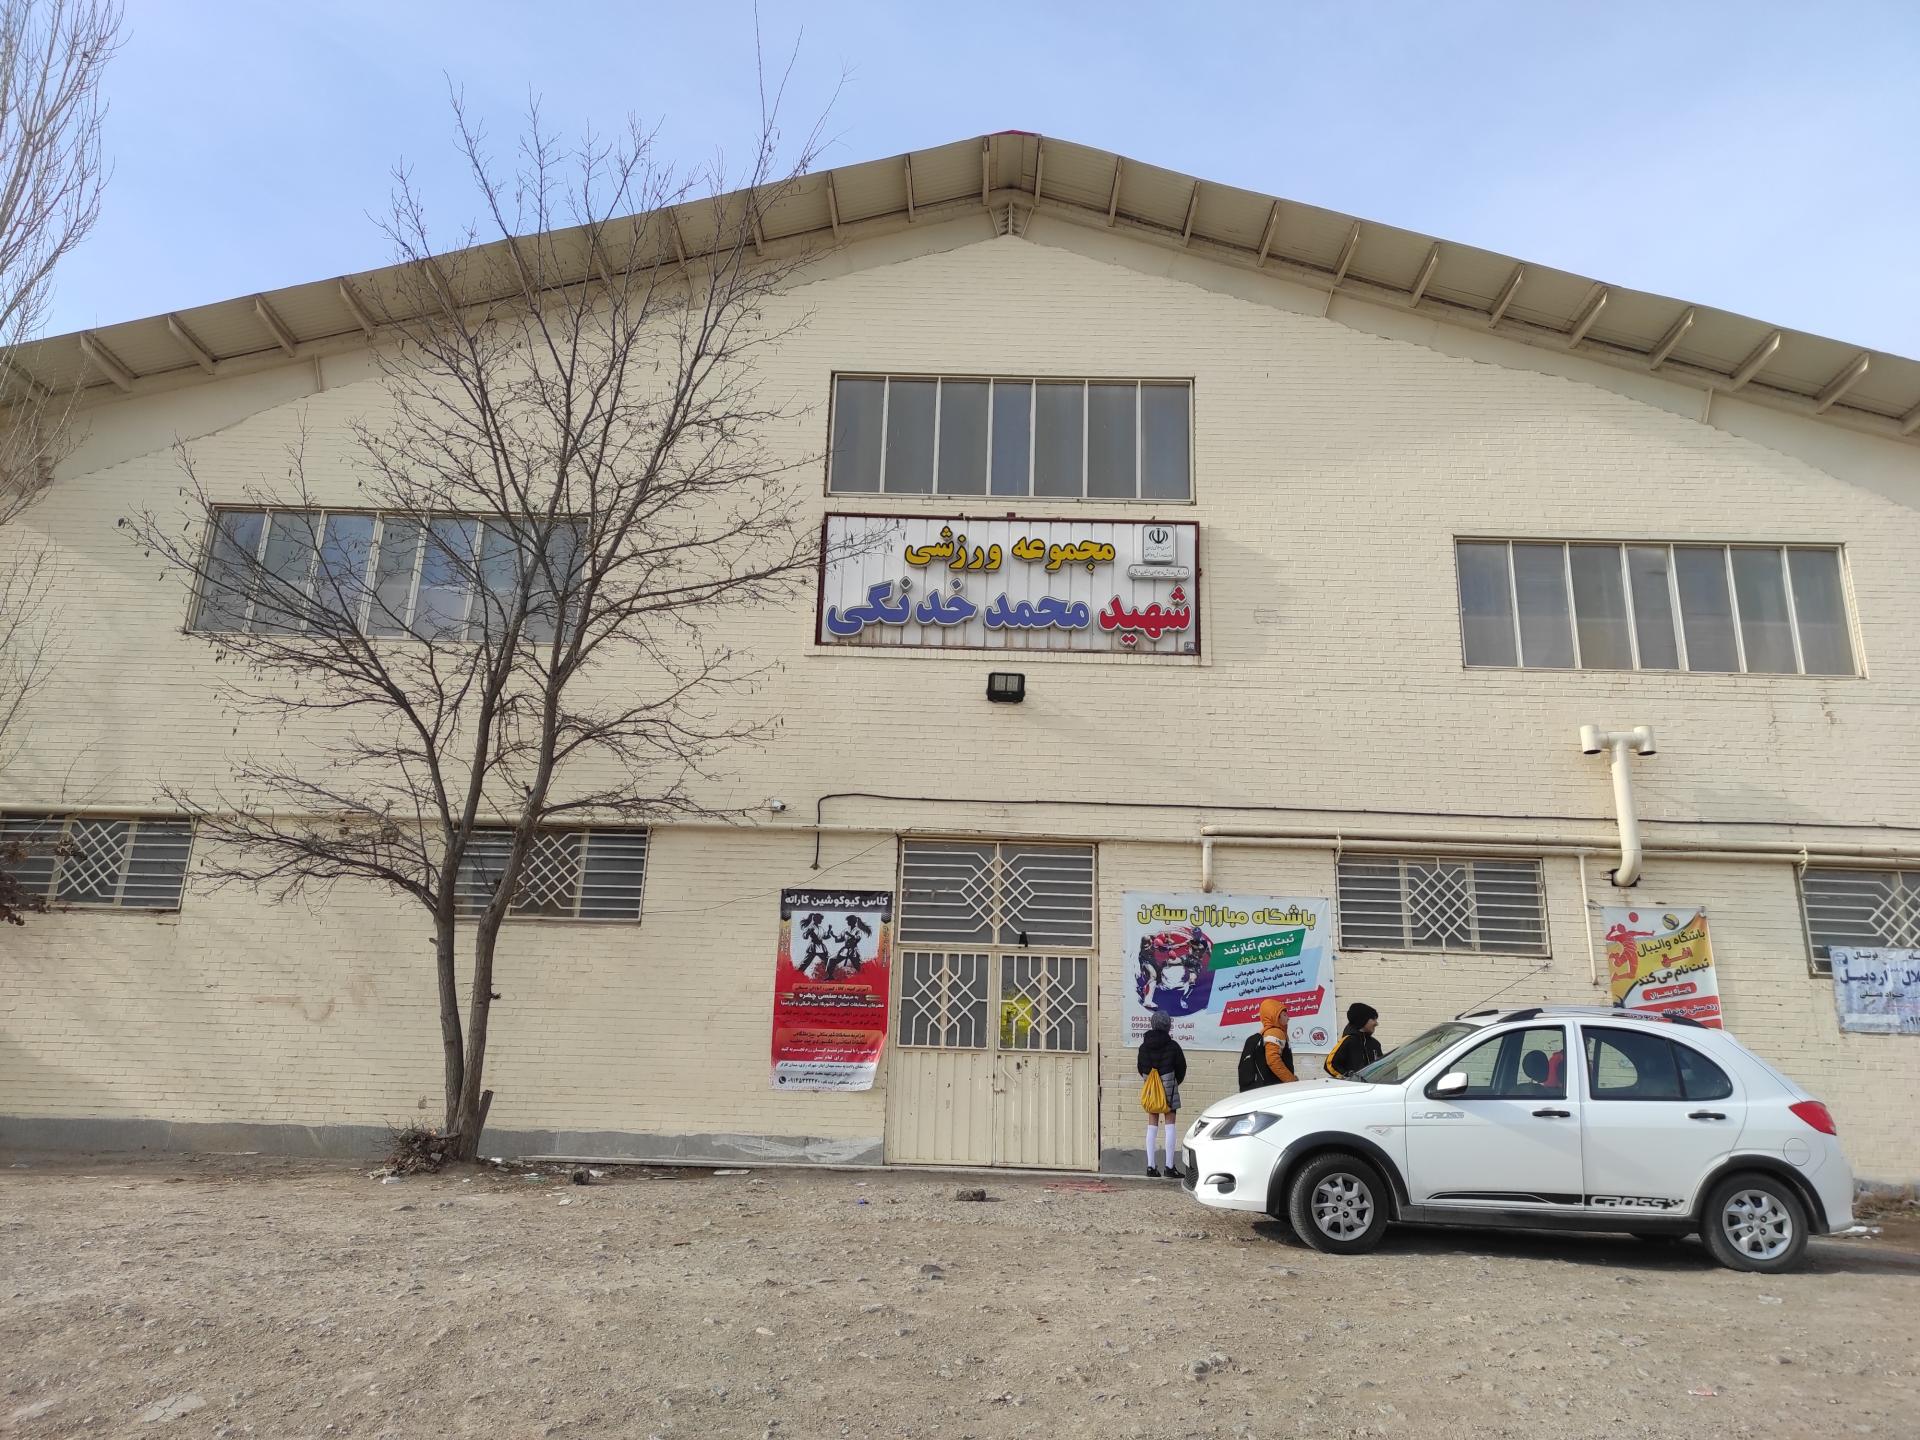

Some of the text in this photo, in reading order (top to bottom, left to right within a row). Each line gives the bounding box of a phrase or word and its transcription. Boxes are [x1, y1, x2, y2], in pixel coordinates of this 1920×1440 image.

[904, 525, 1115, 571] مجموعه ورزشی
[827, 575, 1191, 645] شهید محمد خدنگی
[785, 894, 889, 907] کلاس کیوکوشین کاراته
[1137, 903, 1316, 930] باشگاه مبارزان سبلان
[1257, 938, 1273, 952] نام
[1273, 933, 1295, 947] ثبت
[1637, 929, 1705, 957] باشگاه والیبال
[1237, 956, 1258, 966] بانوان
[1264, 948, 1284, 960] آقایان
[1674, 964, 1689, 981] نام
[1688, 958, 1710, 973] ثبت
[1658, 971, 1673, 984] می
[1591, 1195, 1668, 1208] CROSS
